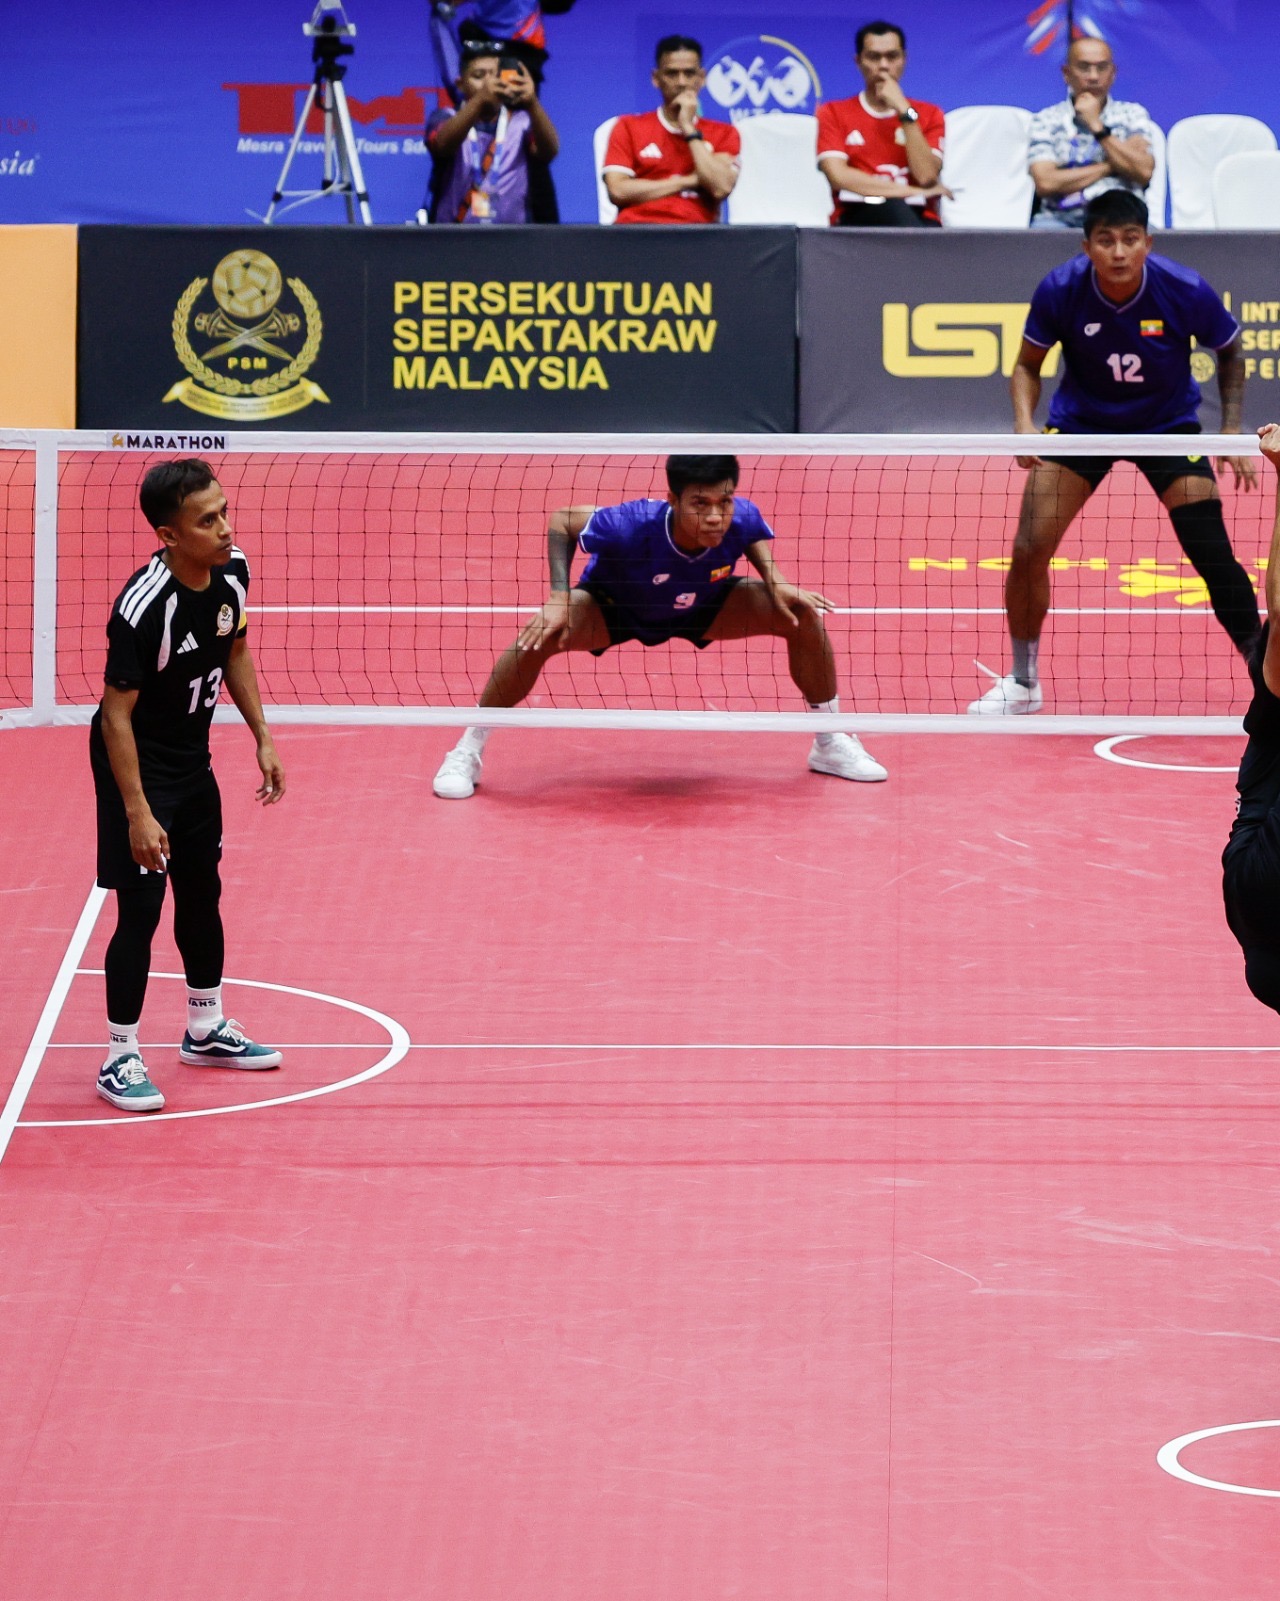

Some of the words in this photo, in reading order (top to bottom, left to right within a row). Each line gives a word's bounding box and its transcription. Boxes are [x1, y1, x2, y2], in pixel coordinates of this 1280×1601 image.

[237, 138, 284, 154] Mesra
[393, 281, 713, 316] PERSEKUTUAN
[392, 318, 718, 353] SEPAKTAKRAW
[227, 356, 268, 371] PSM
[393, 355, 610, 391] MALAYSIA
[1106, 353, 1145, 383] 12
[127, 435, 225, 450] MARATHON
[673, 592, 697, 610] 9
[188, 667, 223, 714] 13
